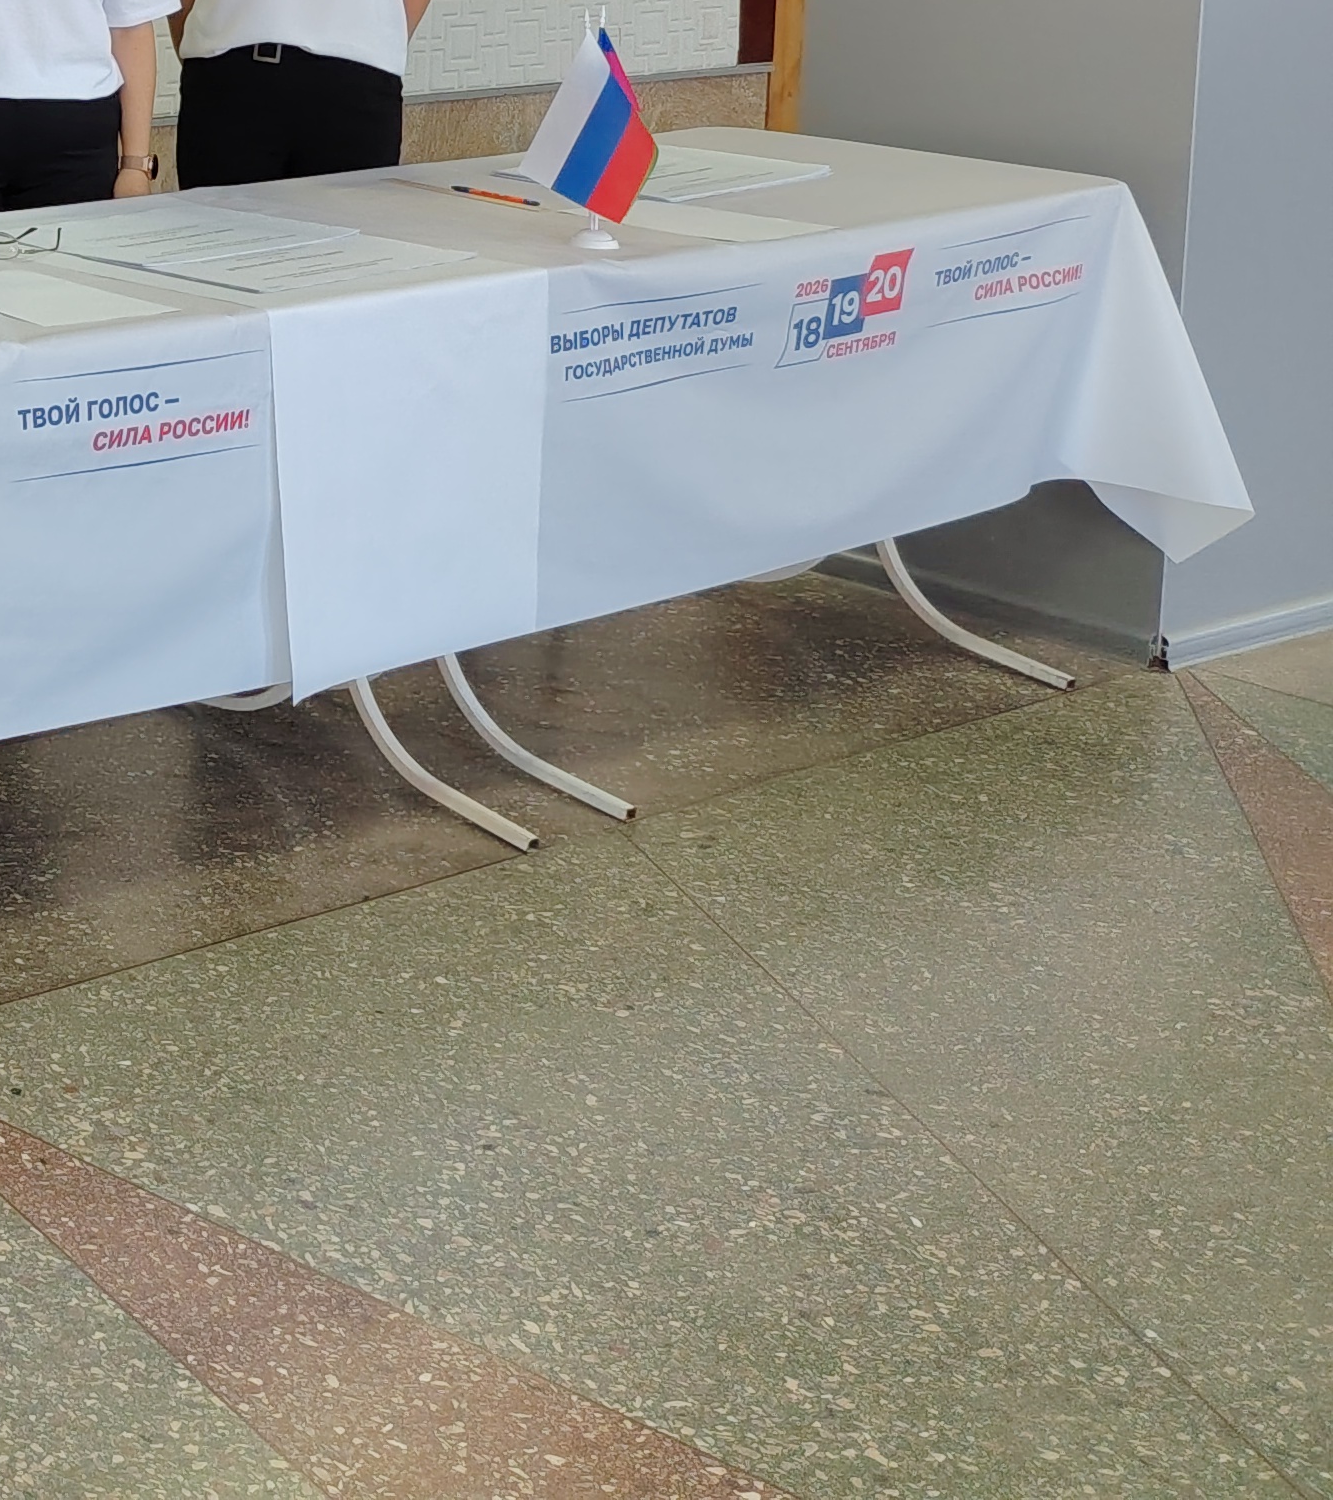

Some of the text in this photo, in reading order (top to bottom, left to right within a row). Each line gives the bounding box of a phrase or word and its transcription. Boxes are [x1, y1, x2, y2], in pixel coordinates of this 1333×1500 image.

[795, 278, 829, 298] 2026
[935, 260, 973, 287] ТВОЙ
[974, 252, 1020, 277] ГОЛОС
[974, 263, 1083, 301] СИЛА РОССИИ!
[793, 266, 902, 351] 18 19 20
[550, 306, 738, 355] ВЫБОРЫ ДЕПУТАТОВ
[826, 331, 897, 359] СЕНТЯБРЯ
[564, 332, 754, 382] ГОСУДАРСТВЕННОЙ ДУМЫ
[17, 396, 80, 431] ТВОЙ
[86, 391, 161, 422] ГОЛОС
[92, 408, 251, 452] СИЛА РОССИИ!
